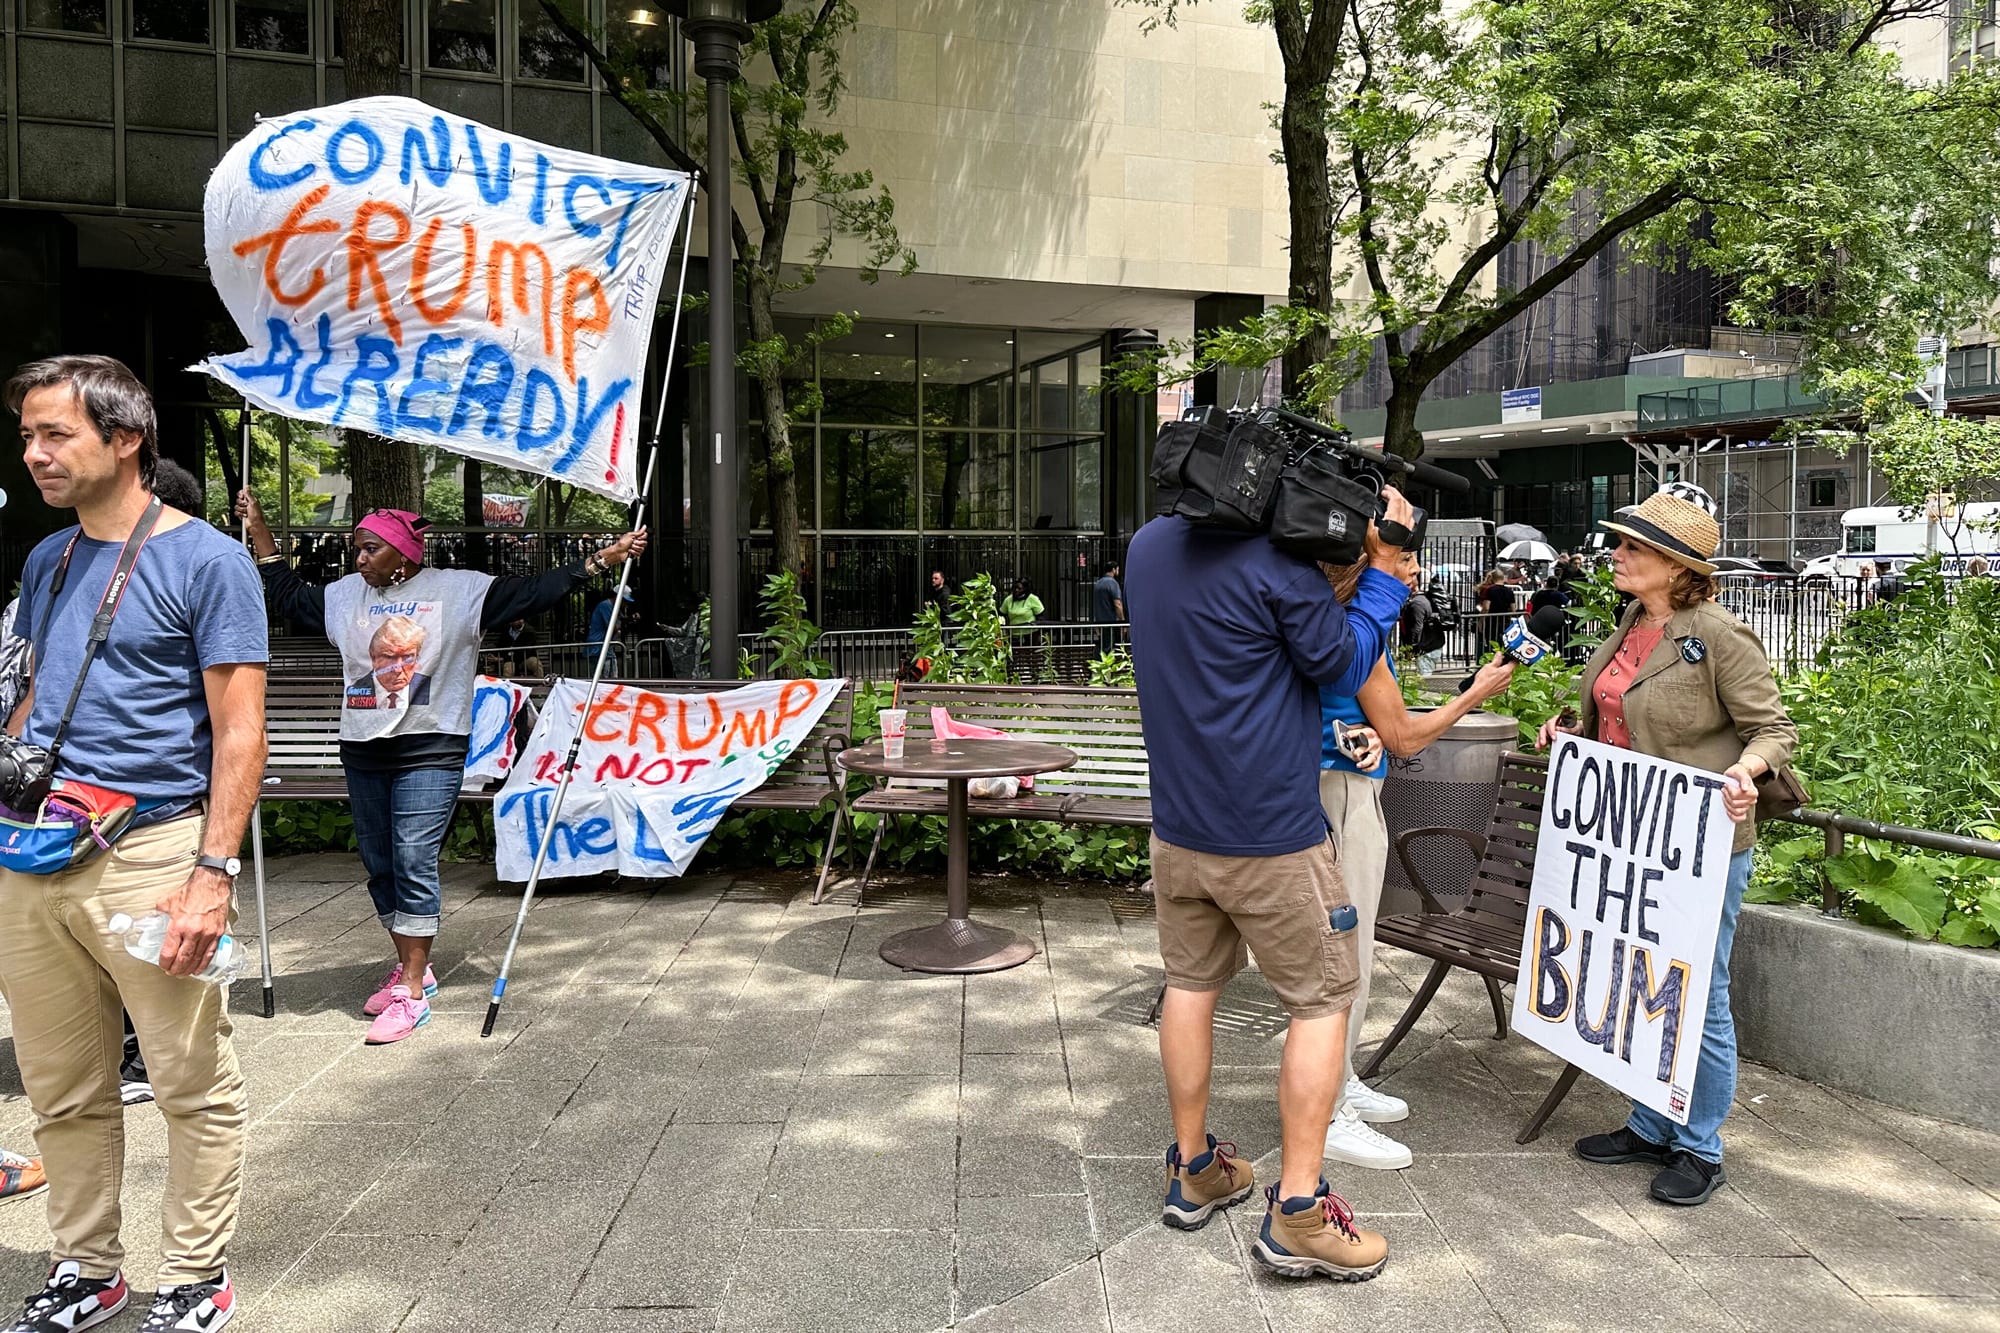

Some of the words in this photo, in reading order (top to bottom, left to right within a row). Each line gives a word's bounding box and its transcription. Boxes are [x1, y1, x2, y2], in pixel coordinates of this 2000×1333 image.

[248, 116, 675, 270] CONVICT
[107, 572, 126, 604] Canon
[594, 752, 711, 785] NOT
[1551, 741, 1723, 878] CONVICT
[499, 786, 618, 865] The
[1565, 841, 1664, 945] THE
[1527, 906, 1691, 1084] BUM
